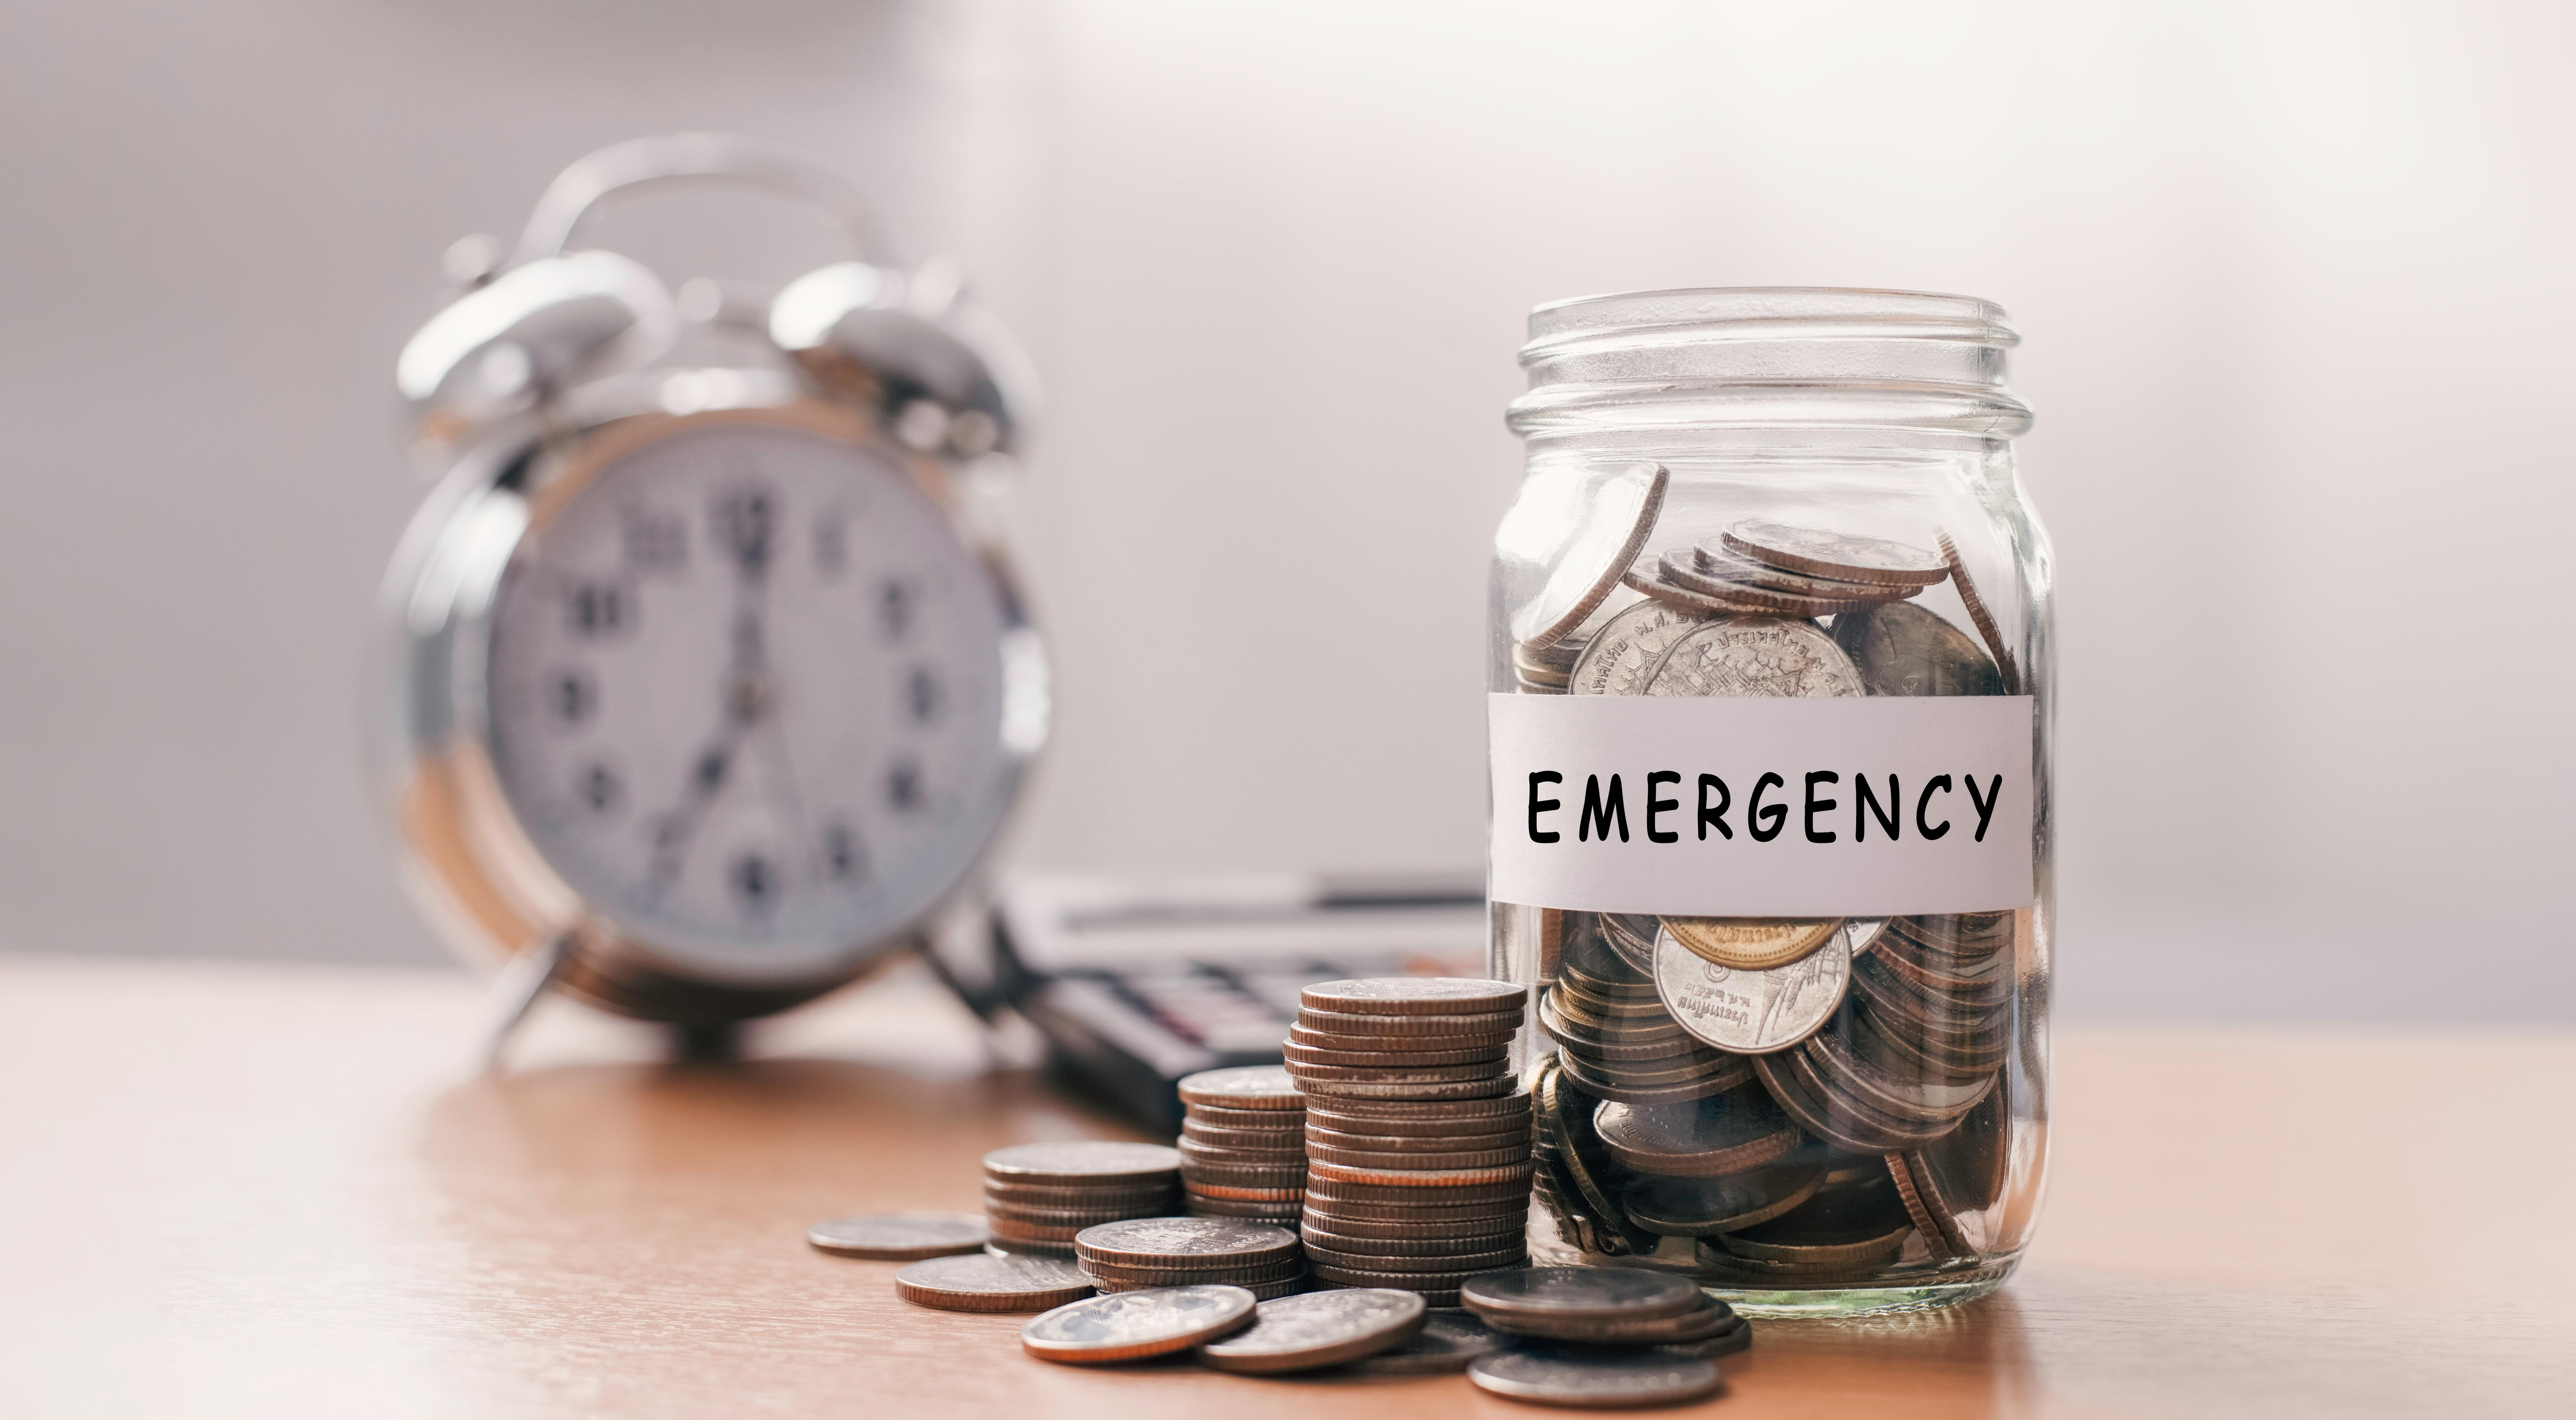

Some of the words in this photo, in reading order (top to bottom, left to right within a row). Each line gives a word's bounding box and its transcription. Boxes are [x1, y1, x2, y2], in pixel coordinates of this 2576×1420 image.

[1528, 770, 2002, 843] EMERGENCY
[1704, 922, 1796, 944] ประเทศไท
[1677, 996, 1748, 1028] ประเทศไทย
